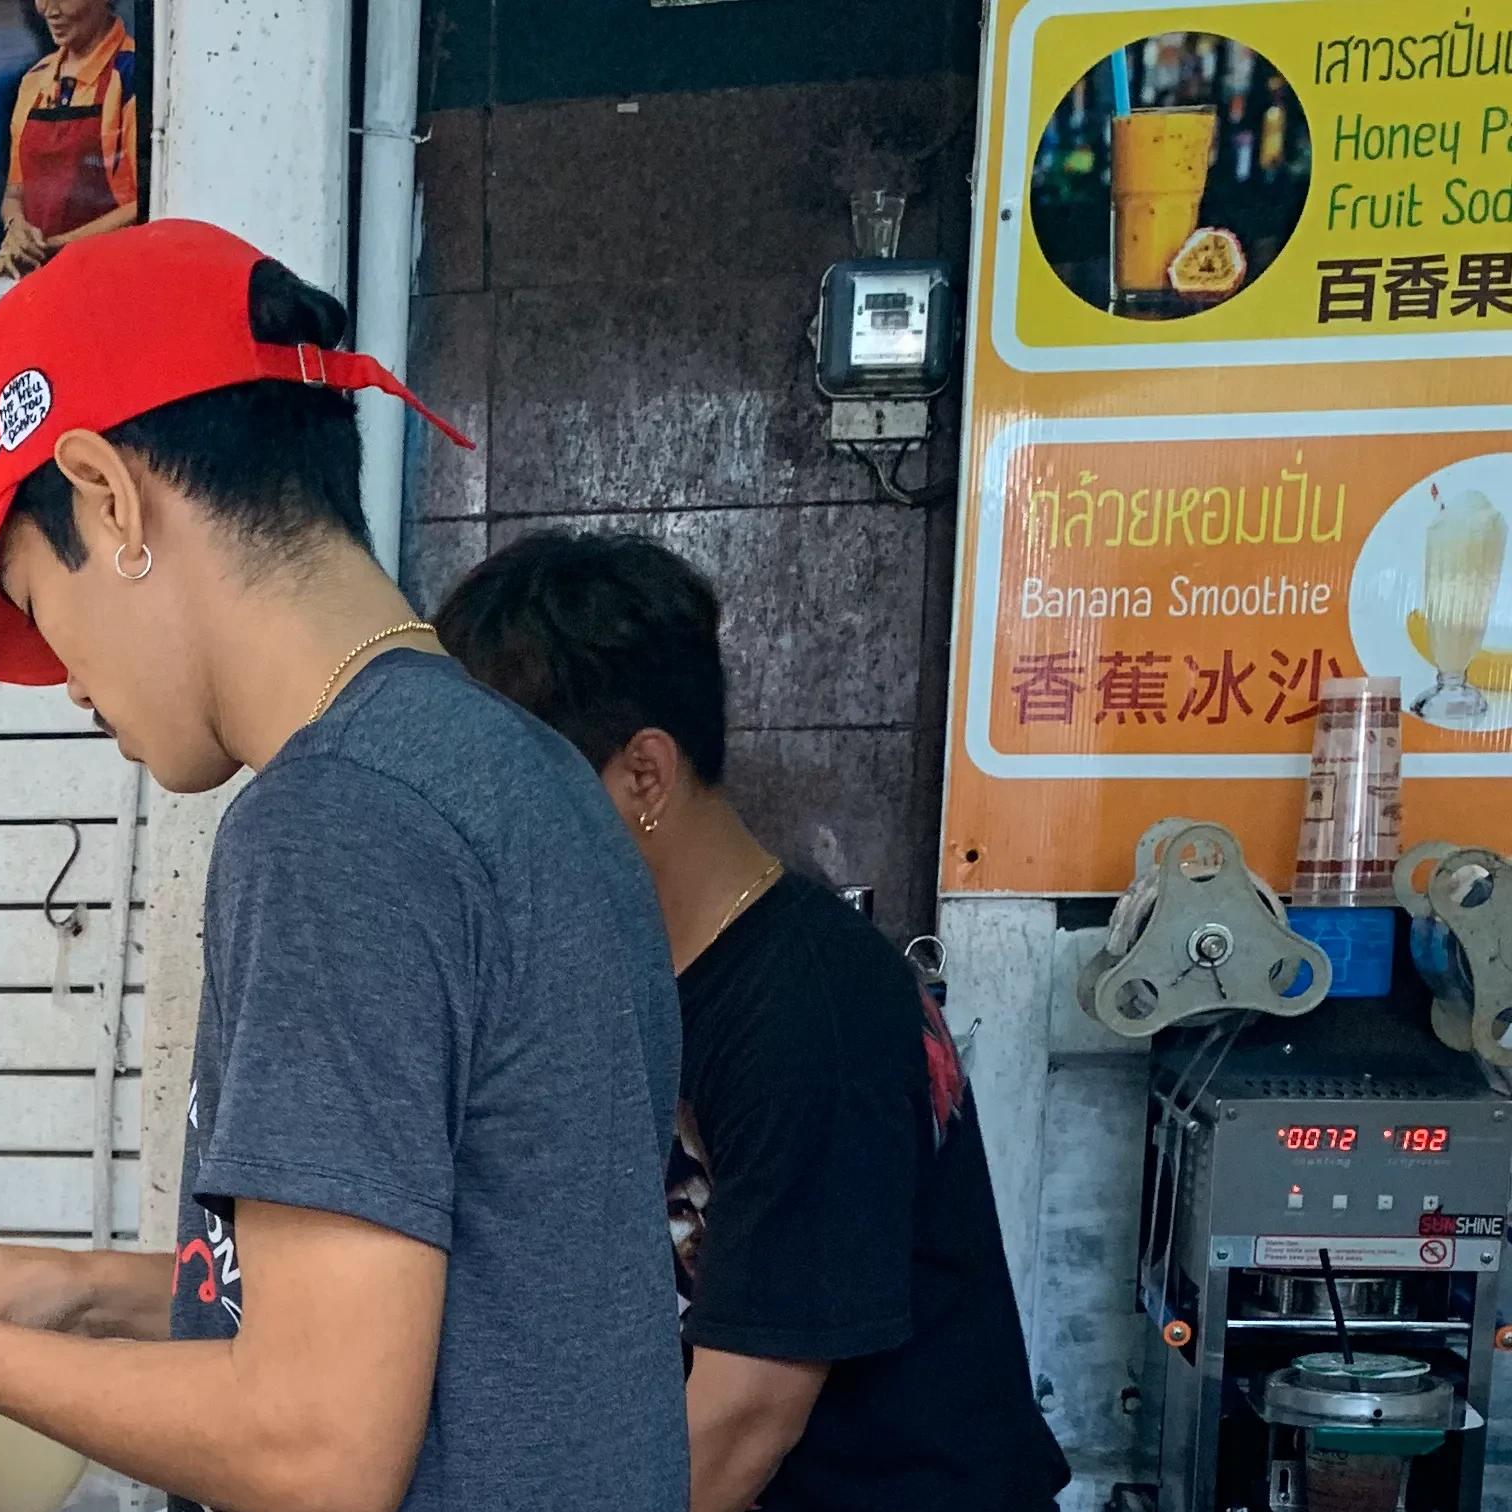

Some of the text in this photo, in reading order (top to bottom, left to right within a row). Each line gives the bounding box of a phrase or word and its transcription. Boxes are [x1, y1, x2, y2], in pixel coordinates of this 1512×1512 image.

[1334, 105, 1512, 165] Honey P
[1328, 182, 1424, 231] Fruit
[1316, 252, 1512, 324] 百香果
[1028, 449, 1346, 550] กล้วยหอมปั่น
[1021, 575, 1332, 620] Banana Smoothie
[1011, 648, 1345, 726] 香蕉冰沙
[1287, 1127, 1357, 1151] 0072
[1401, 1127, 1449, 1151] 192
